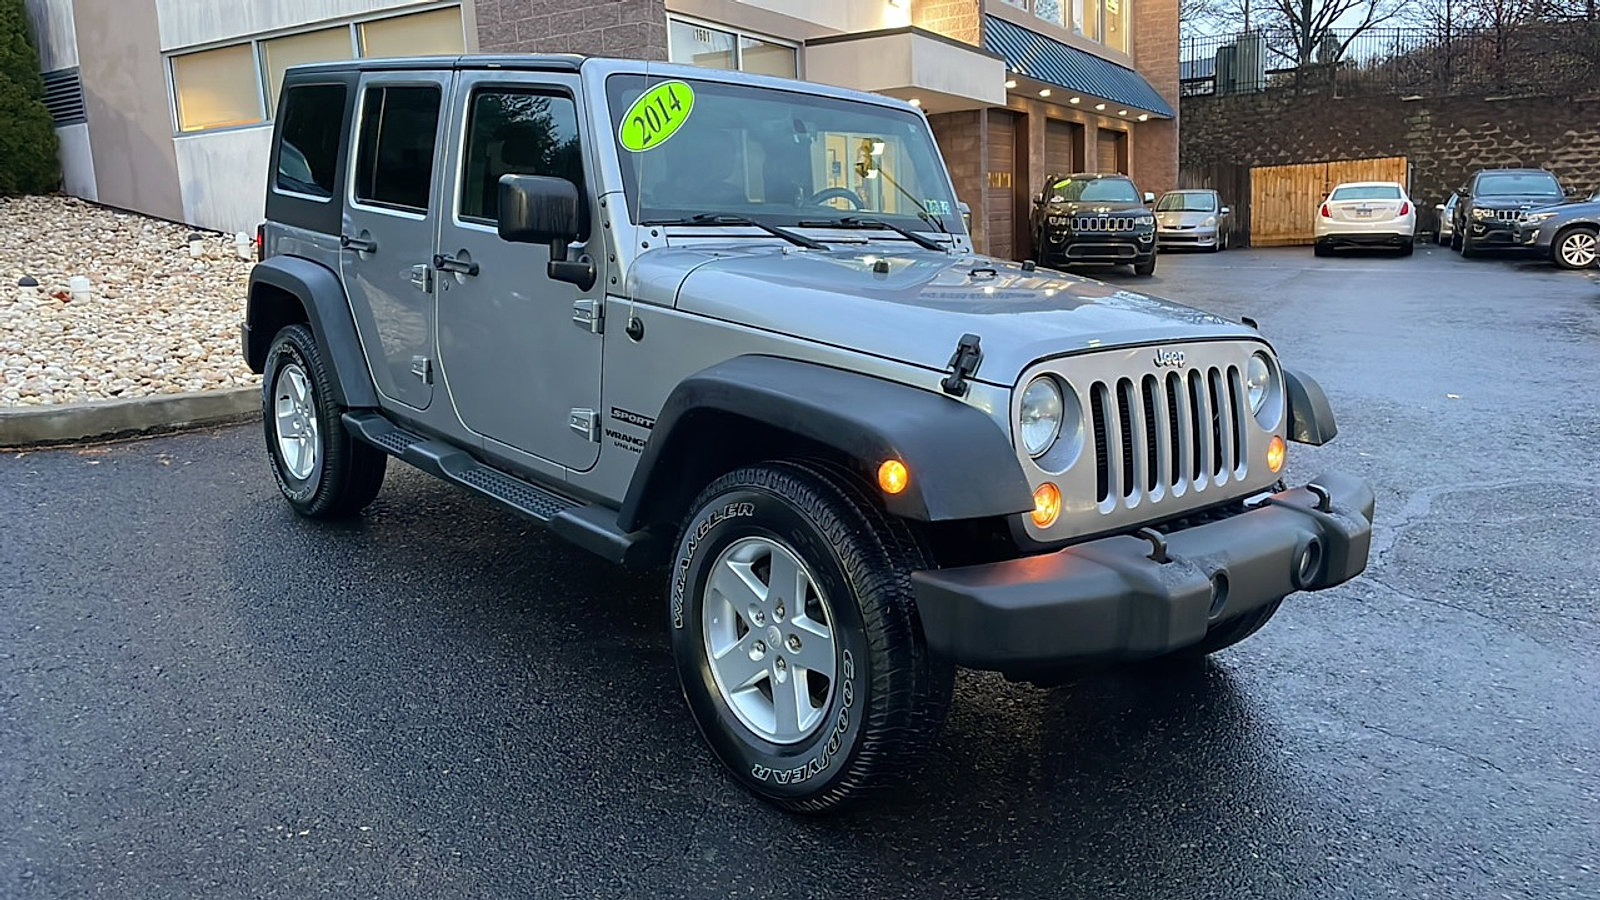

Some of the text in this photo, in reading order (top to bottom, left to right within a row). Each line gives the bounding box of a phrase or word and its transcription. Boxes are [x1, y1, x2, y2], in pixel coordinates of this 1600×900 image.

[633, 86, 682, 145] 2014
[1153, 349, 1185, 368] Jeep
[612, 408, 654, 428] SPORT
[674, 502, 756, 629] WRANGLER
[751, 649, 855, 785] GOODYEAR
